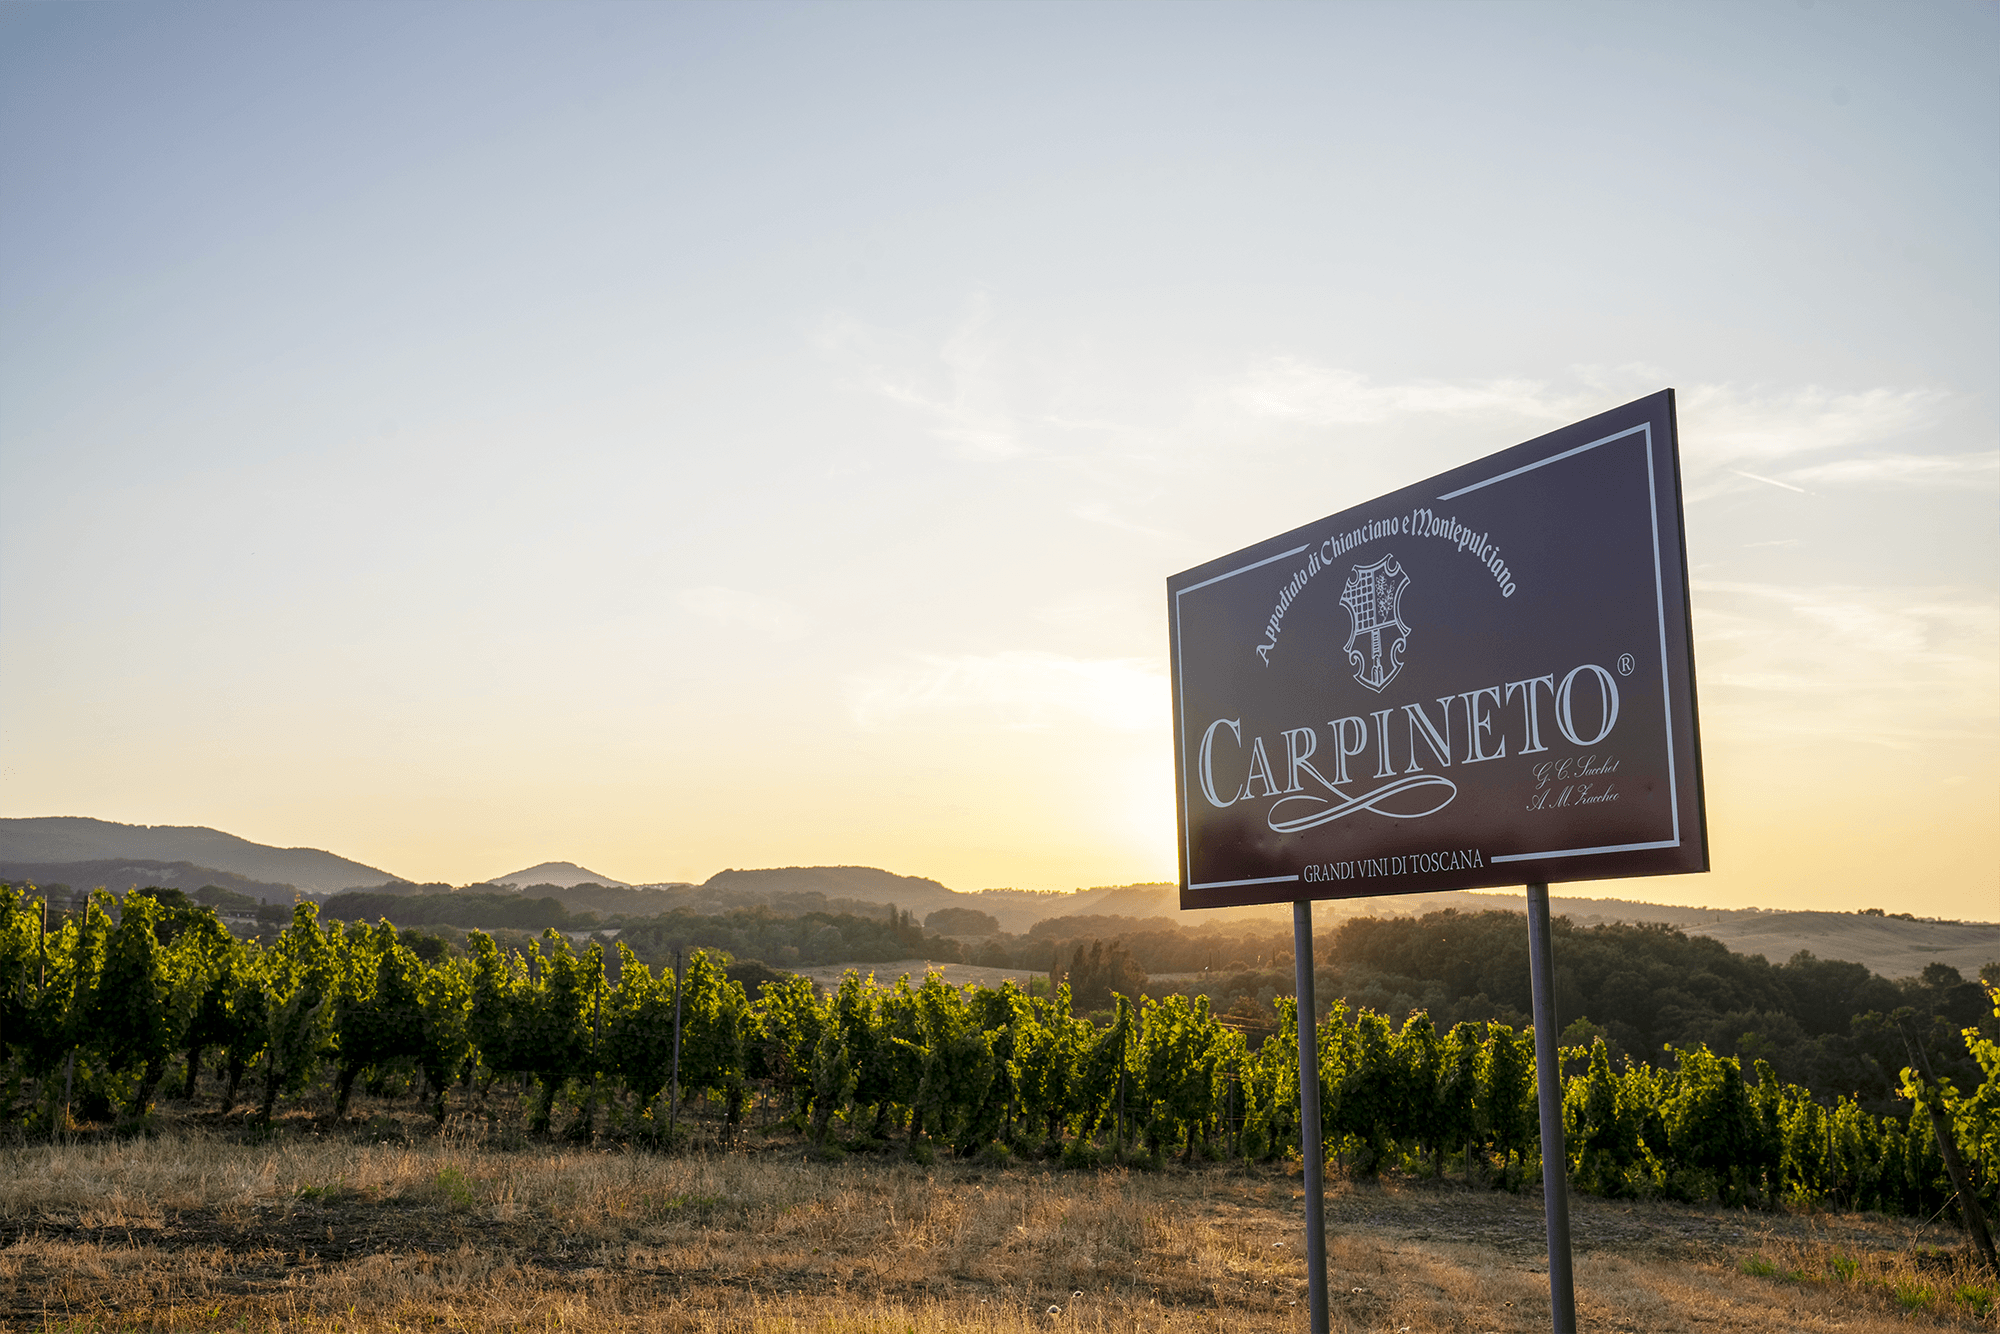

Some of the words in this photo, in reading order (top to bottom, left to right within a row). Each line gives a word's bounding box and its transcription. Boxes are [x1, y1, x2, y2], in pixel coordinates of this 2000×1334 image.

[1256, 572, 1308, 668] Appodiato
[1309, 552, 1321, 577] di
[1320, 516, 1399, 566] Chianciano
[1402, 516, 1410, 534] e
[1411, 508, 1516, 598] Montepulciano
[1199, 664, 1620, 808] CARPINETO
[1303, 861, 1355, 883] GRANDI
[1357, 857, 1389, 878] VINI
[1391, 856, 1407, 876] DI
[1410, 849, 1484, 874] TOSCANA
